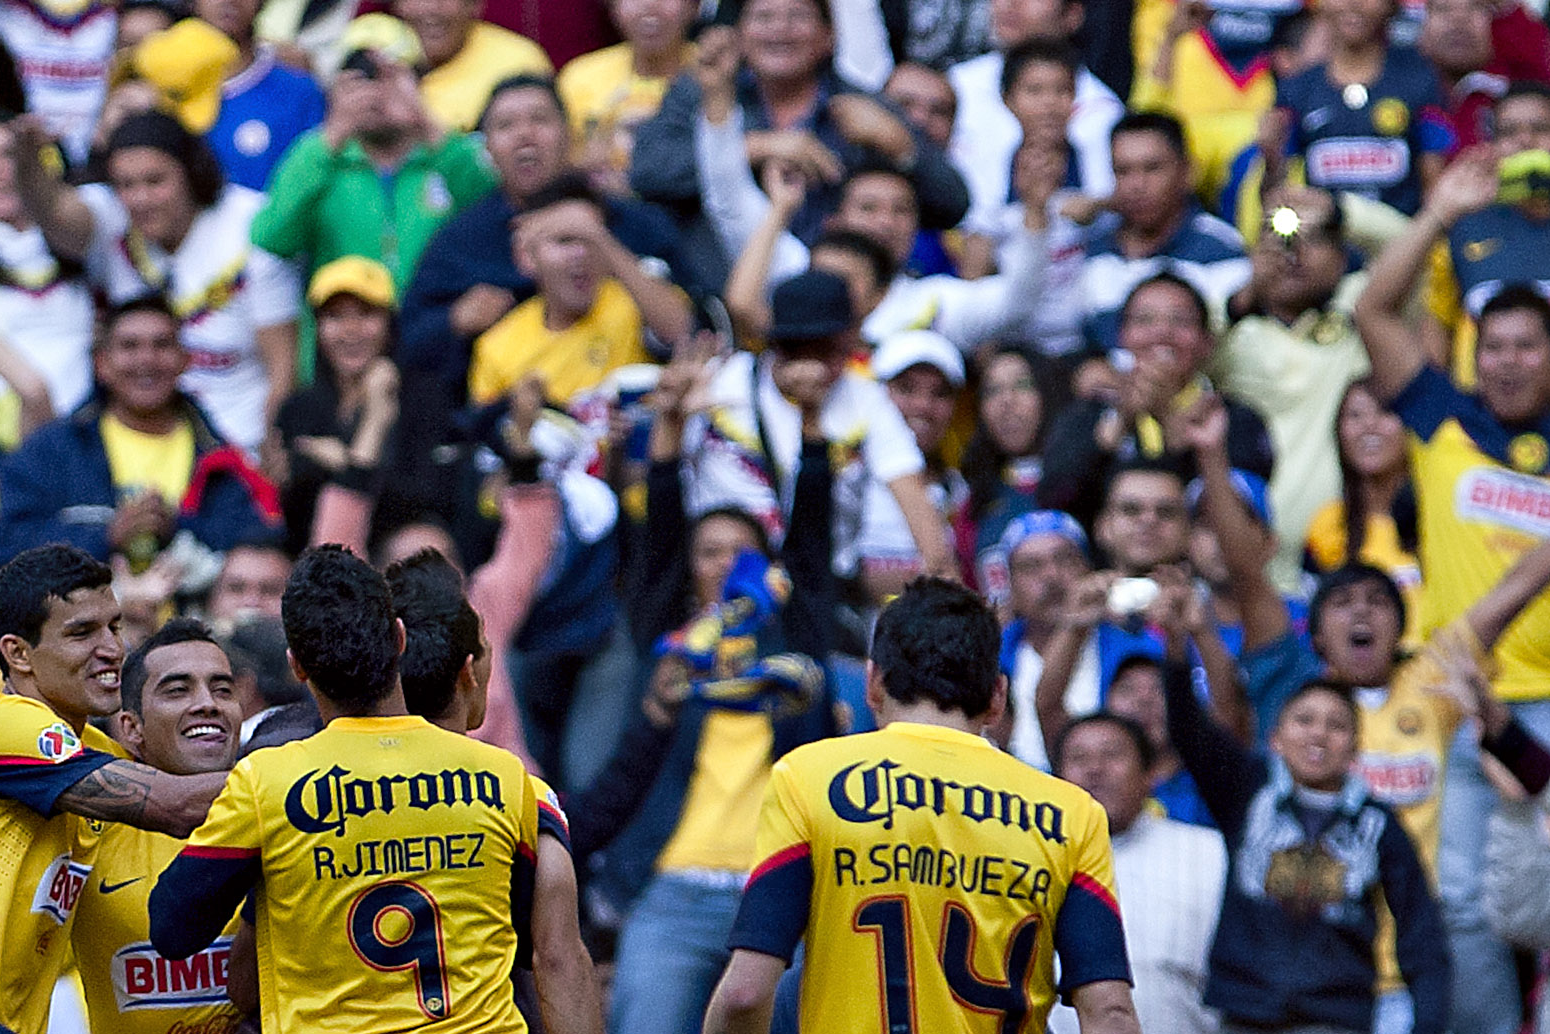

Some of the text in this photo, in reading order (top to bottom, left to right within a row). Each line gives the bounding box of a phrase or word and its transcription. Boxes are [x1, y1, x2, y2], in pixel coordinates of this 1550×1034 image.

[285, 764, 506, 837] Corona
[828, 758, 1067, 847] Corona
[313, 832, 485, 881] R.JIMENEZ
[834, 843, 1052, 907] R.SAMBUEZA
[346, 878, 452, 1021] 9
